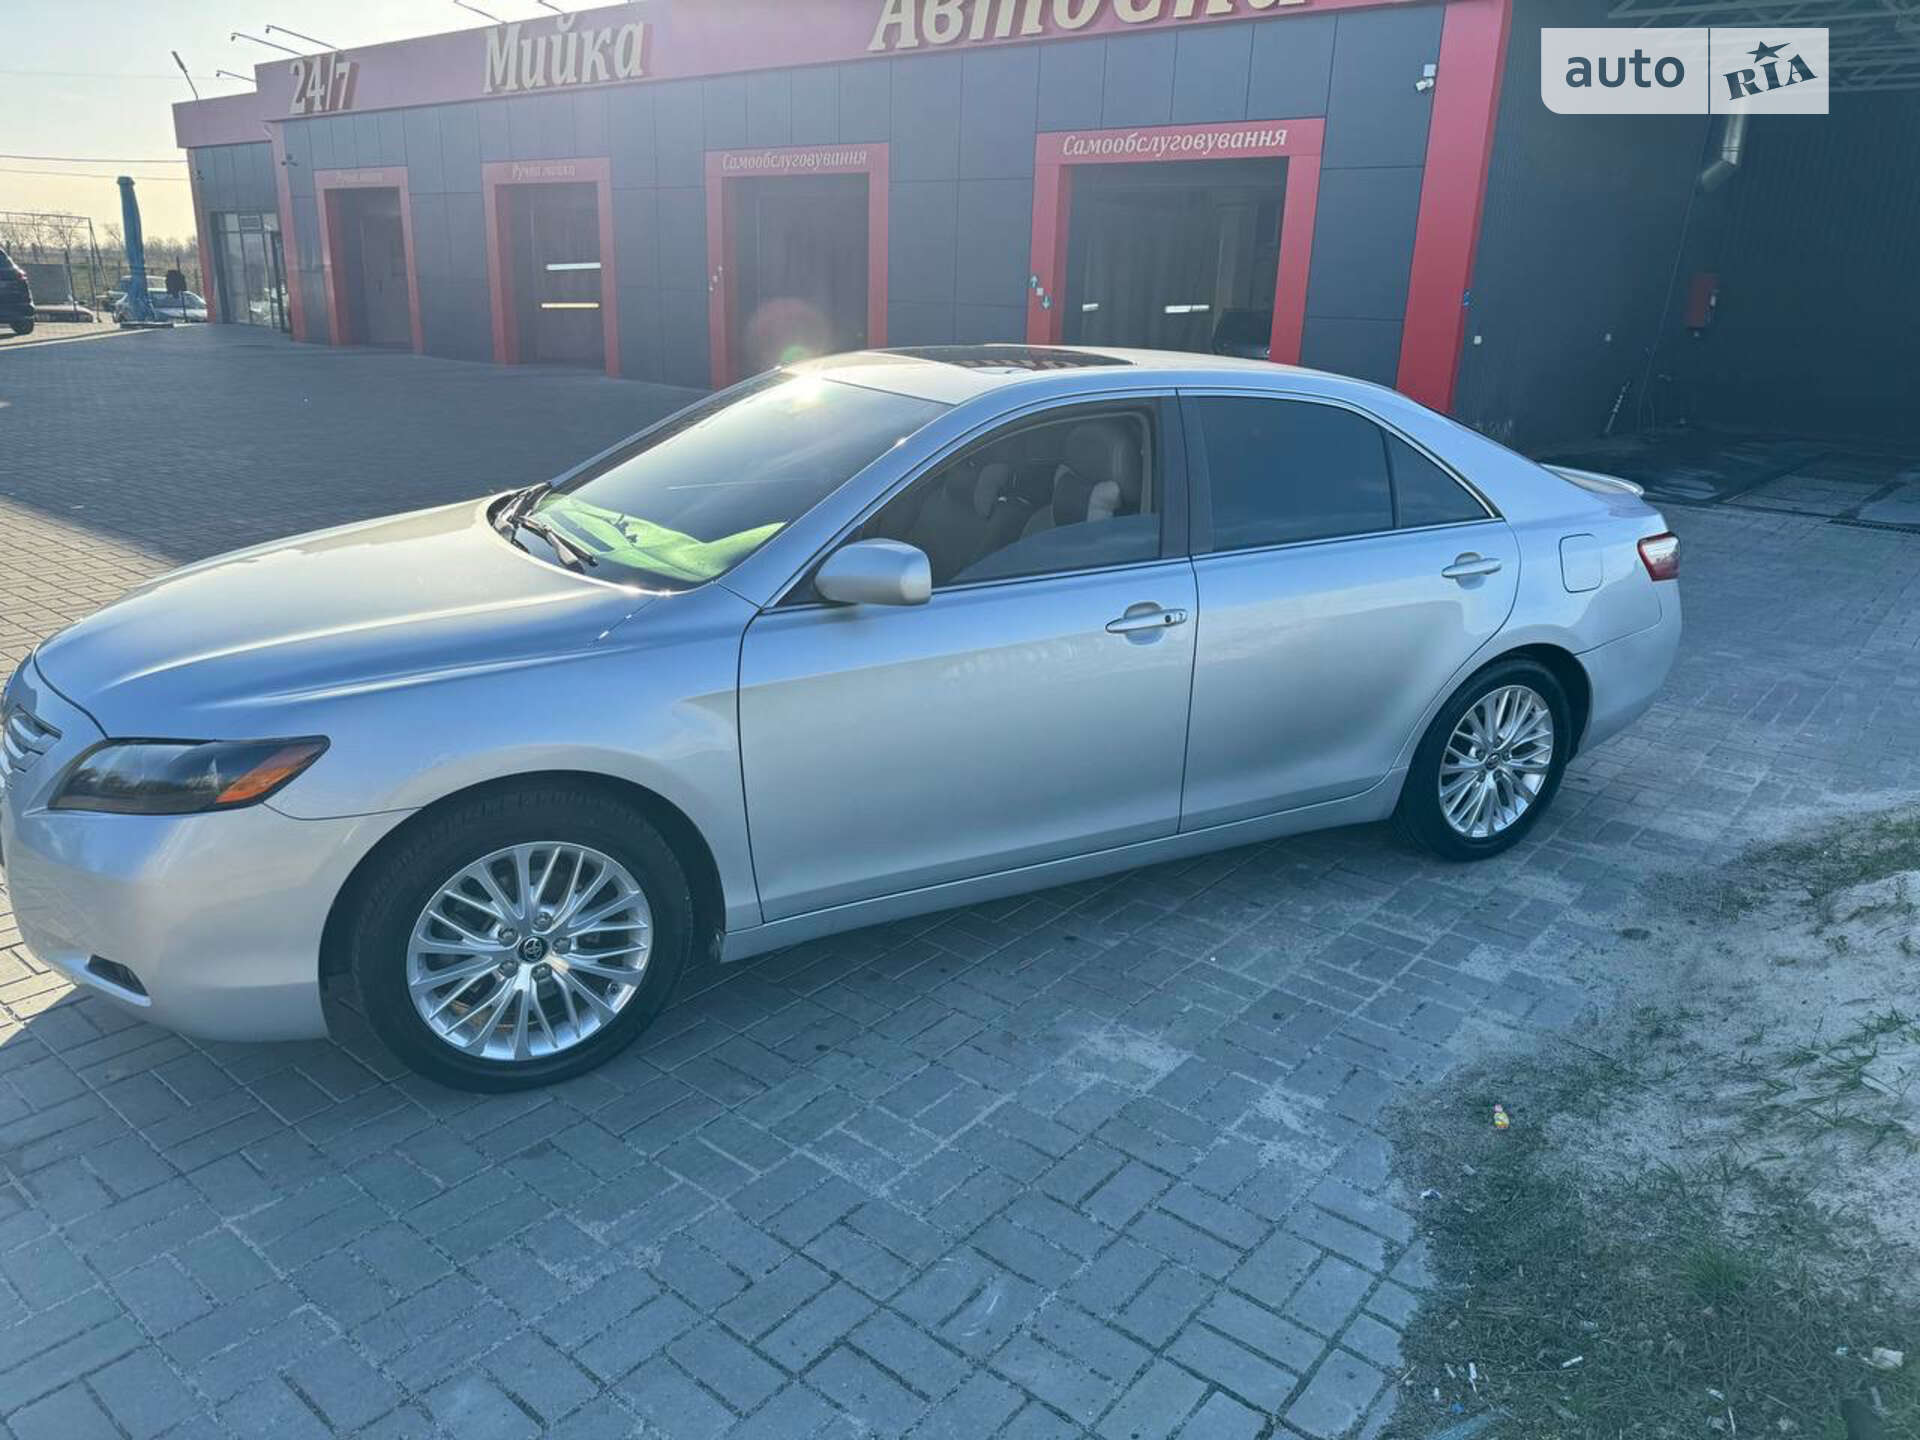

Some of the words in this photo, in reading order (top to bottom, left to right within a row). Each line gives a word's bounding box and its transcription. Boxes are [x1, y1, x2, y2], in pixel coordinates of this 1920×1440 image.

[484, 14, 643, 93] Мийка
[289, 53, 352, 114] 24/7
[721, 149, 867, 172] Самообслуговування
[1063, 128, 1288, 157] Самообслуговування
